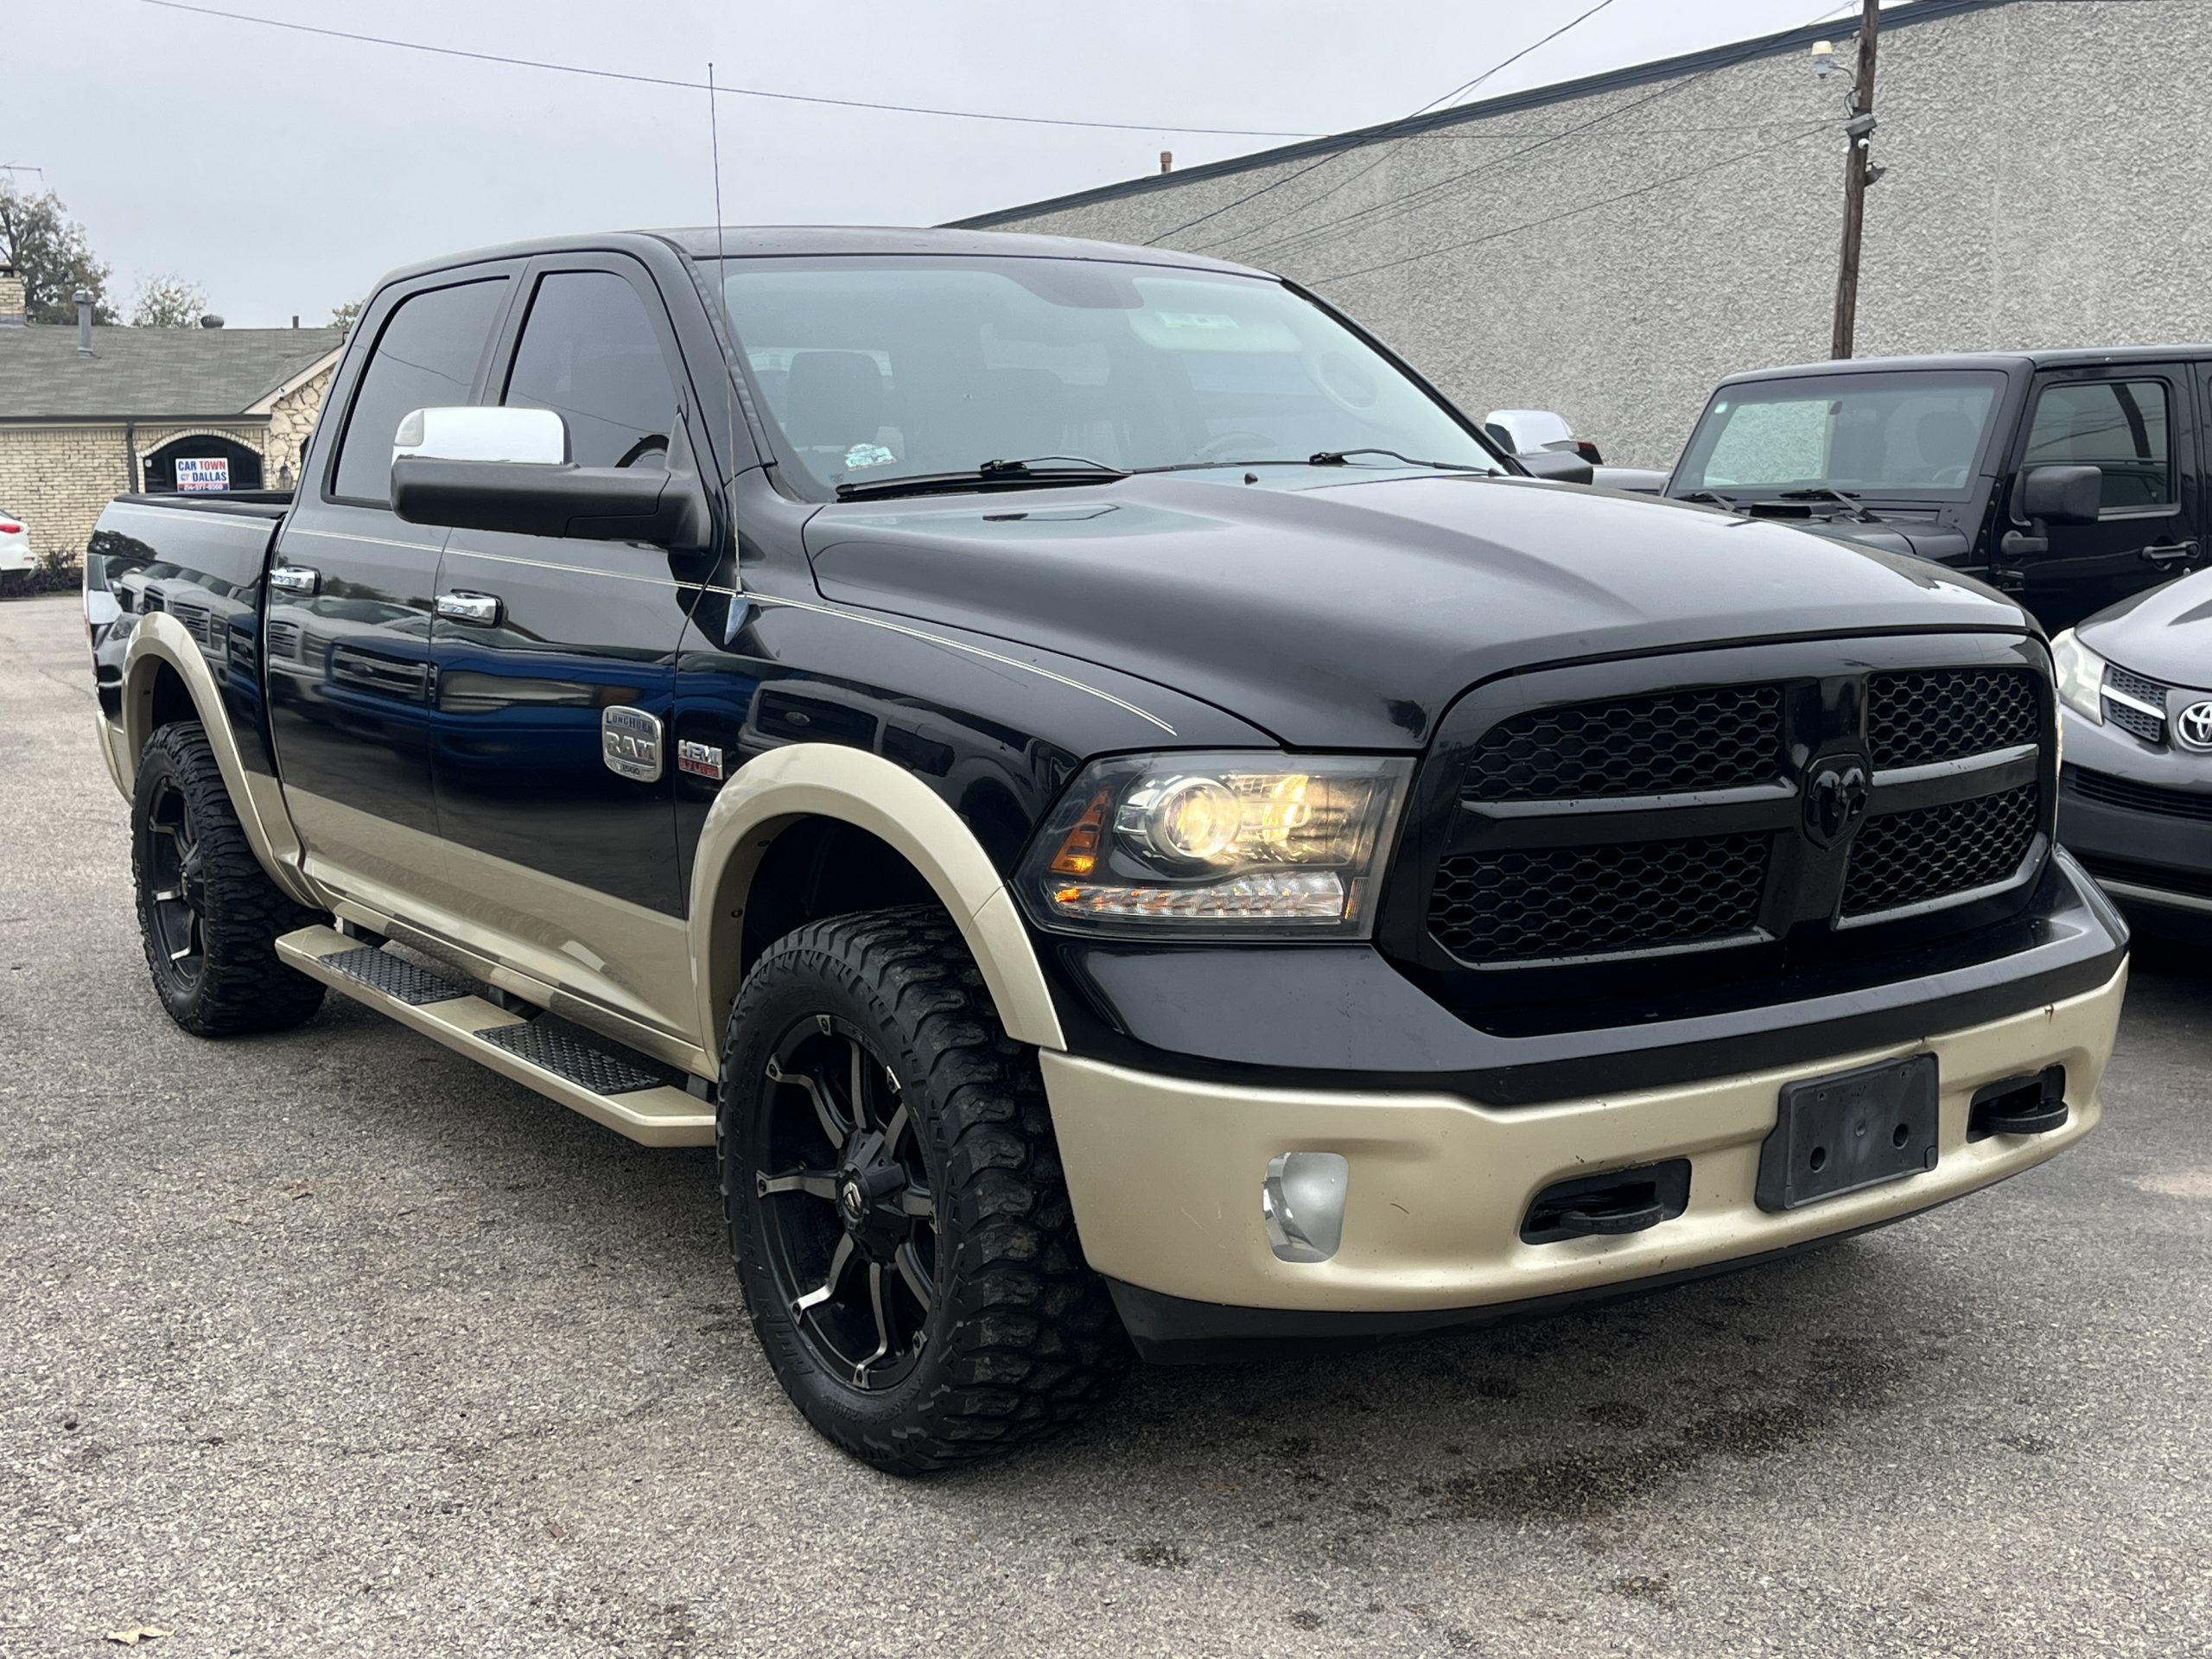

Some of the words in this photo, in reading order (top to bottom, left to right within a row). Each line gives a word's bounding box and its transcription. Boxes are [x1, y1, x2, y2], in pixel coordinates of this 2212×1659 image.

[178, 461, 197, 471] CAR
[200, 461, 226, 470] TOWN
[193, 472, 226, 481] DALLAS
[606, 731, 656, 762] RAM
[678, 739, 722, 766] HEMI
